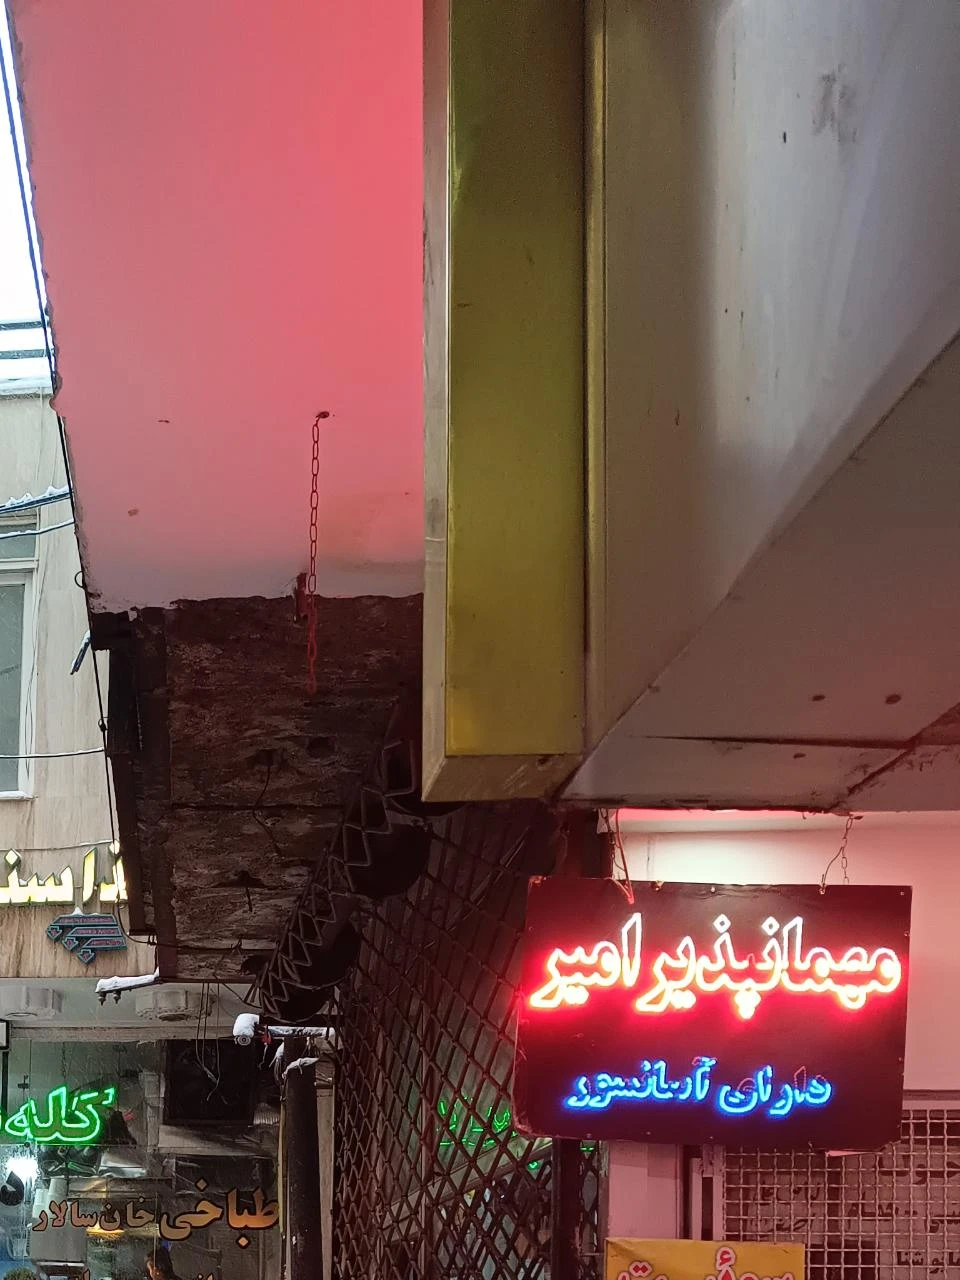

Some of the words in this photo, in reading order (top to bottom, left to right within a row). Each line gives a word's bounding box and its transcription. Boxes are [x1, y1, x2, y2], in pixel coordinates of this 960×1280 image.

[529, 912, 643, 1008] امیر
[567, 1056, 719, 1108] آسانسور
[718, 1064, 833, 1116] دارای
[5, 1085, 117, 1143] کله
[33, 1199, 98, 1232] سالار
[99, 1197, 156, 1232] خان
[159, 1178, 280, 1249] طباخی
